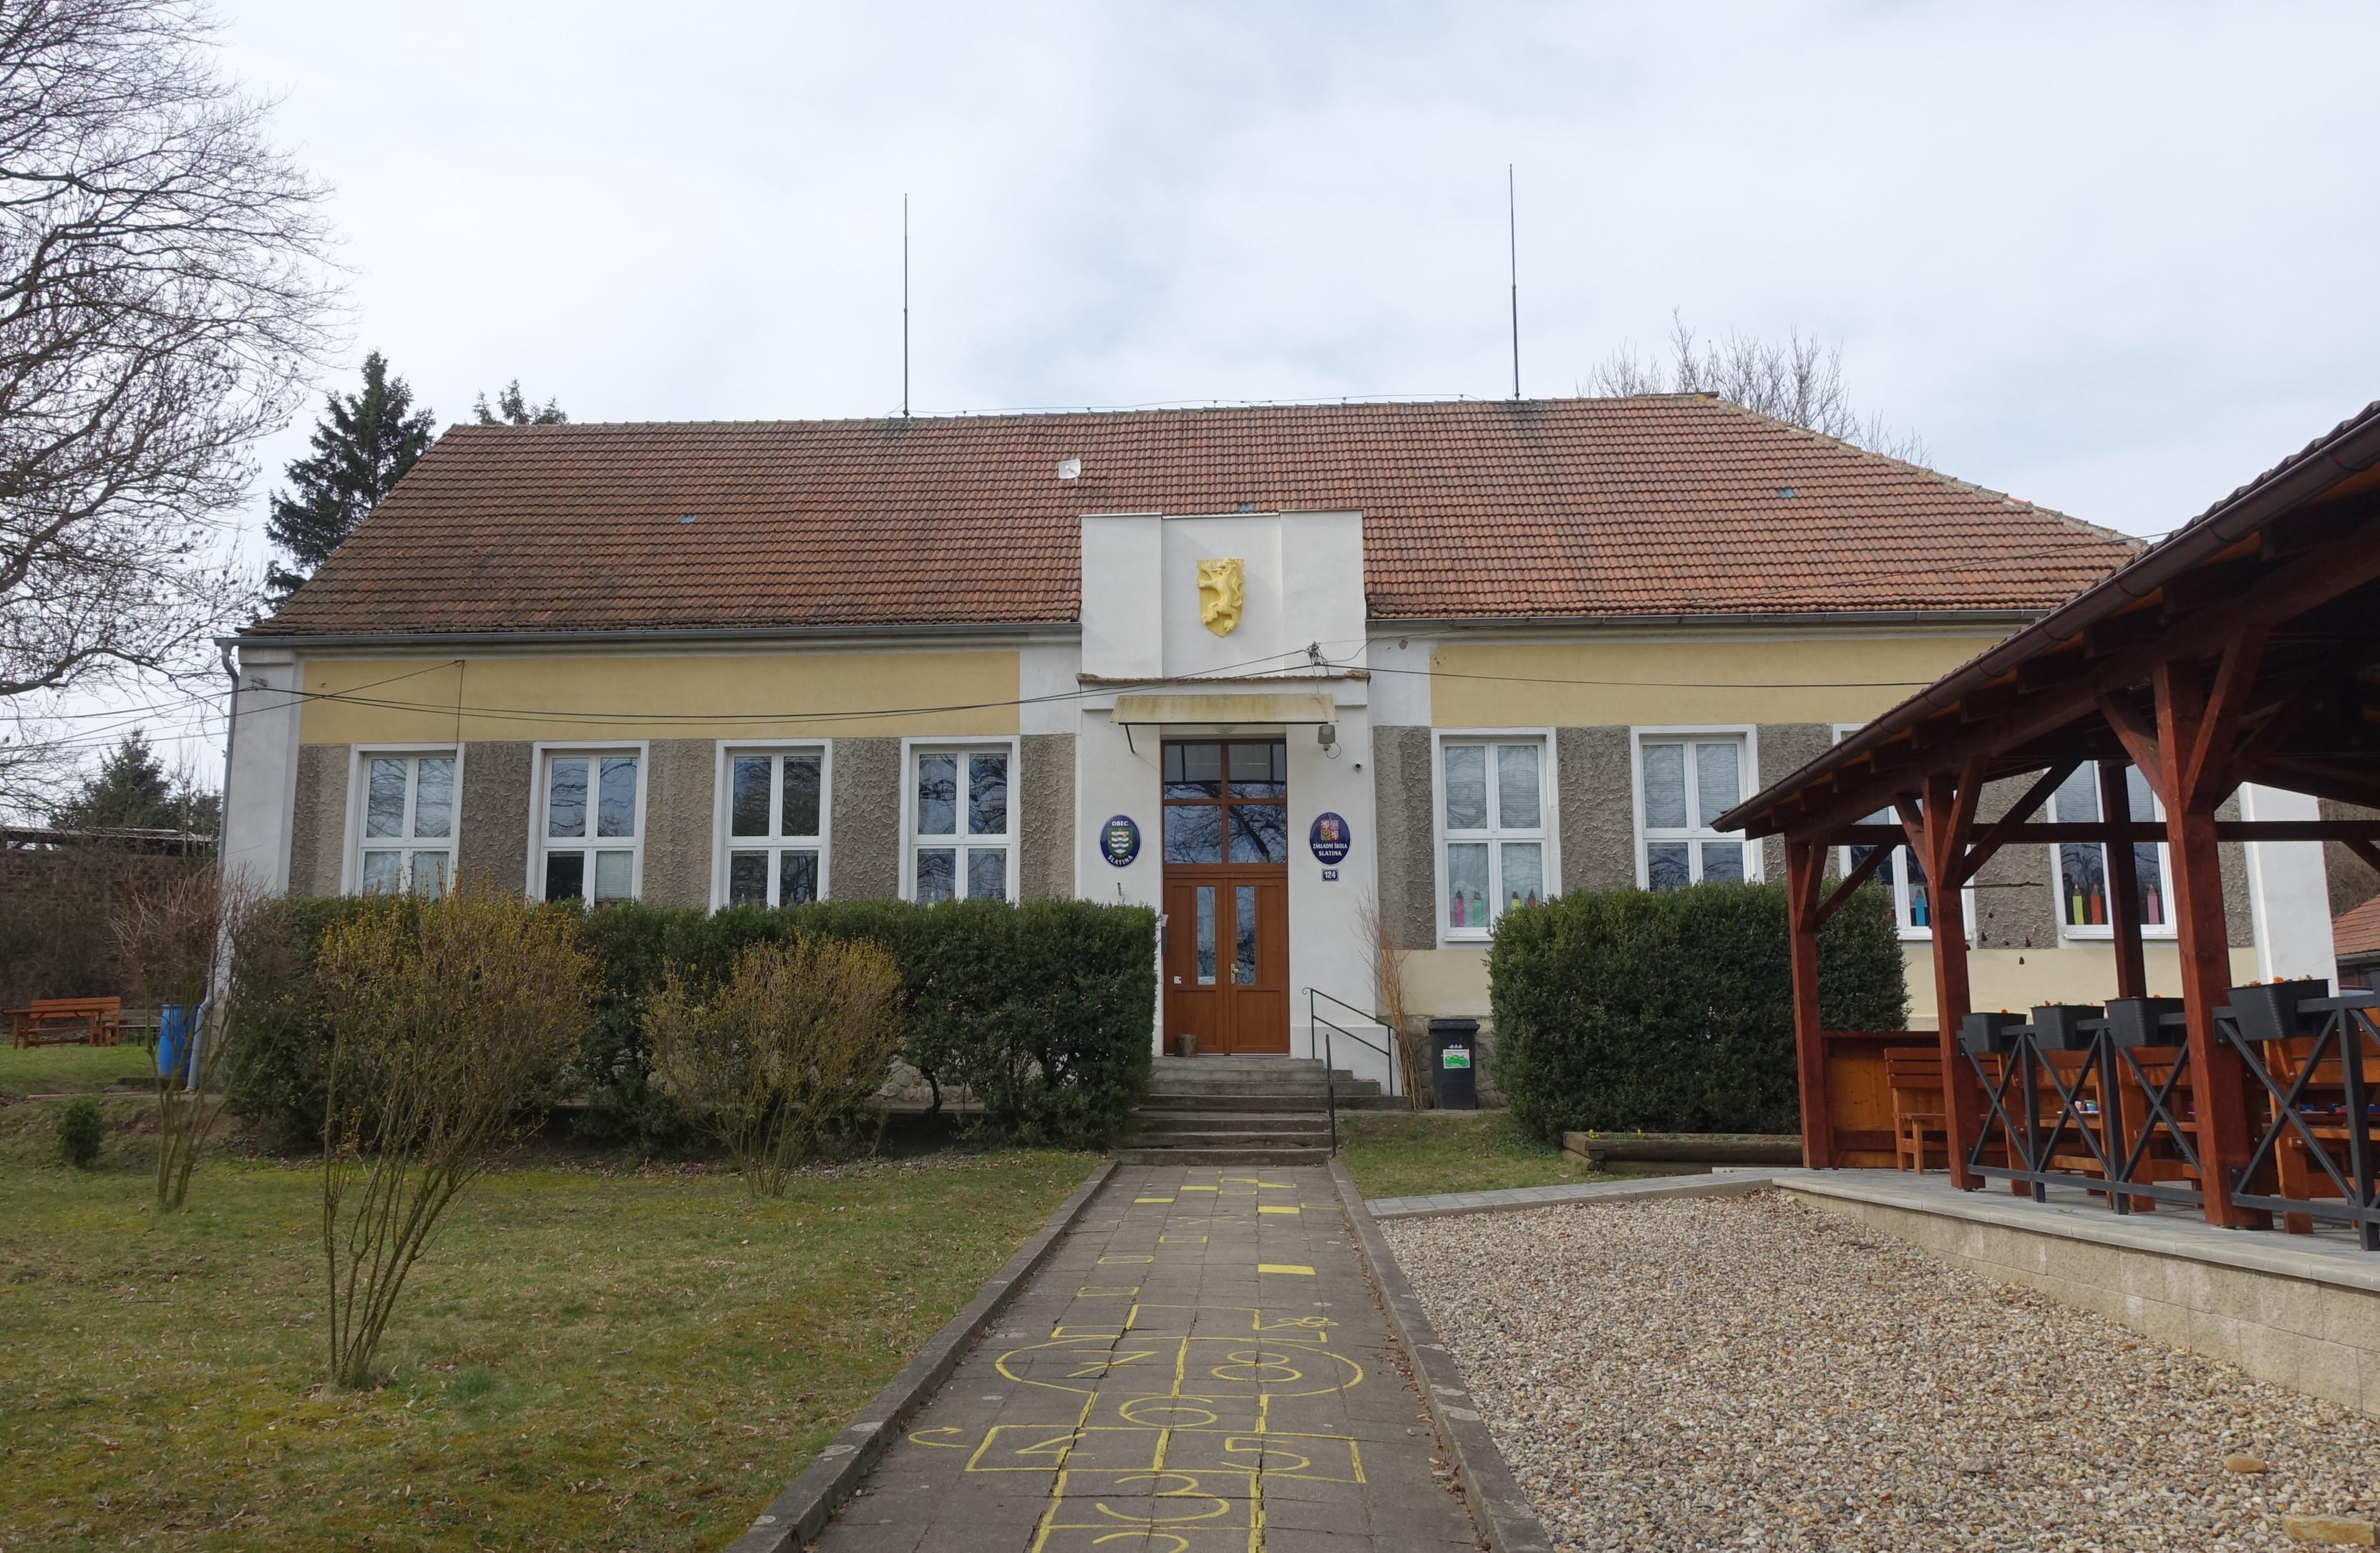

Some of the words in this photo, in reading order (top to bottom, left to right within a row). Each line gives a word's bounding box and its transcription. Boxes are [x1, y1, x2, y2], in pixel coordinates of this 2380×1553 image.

[1107, 855, 1134, 865] SLATINA
[1067, 1350, 1157, 1378] 7
[1211, 1350, 1303, 1382] 8
[1119, 1396, 1218, 1428] 6
[1014, 1433, 1093, 1464] 4
[1219, 1436, 1311, 1472] 5
[1095, 1474, 1230, 1522] 3
